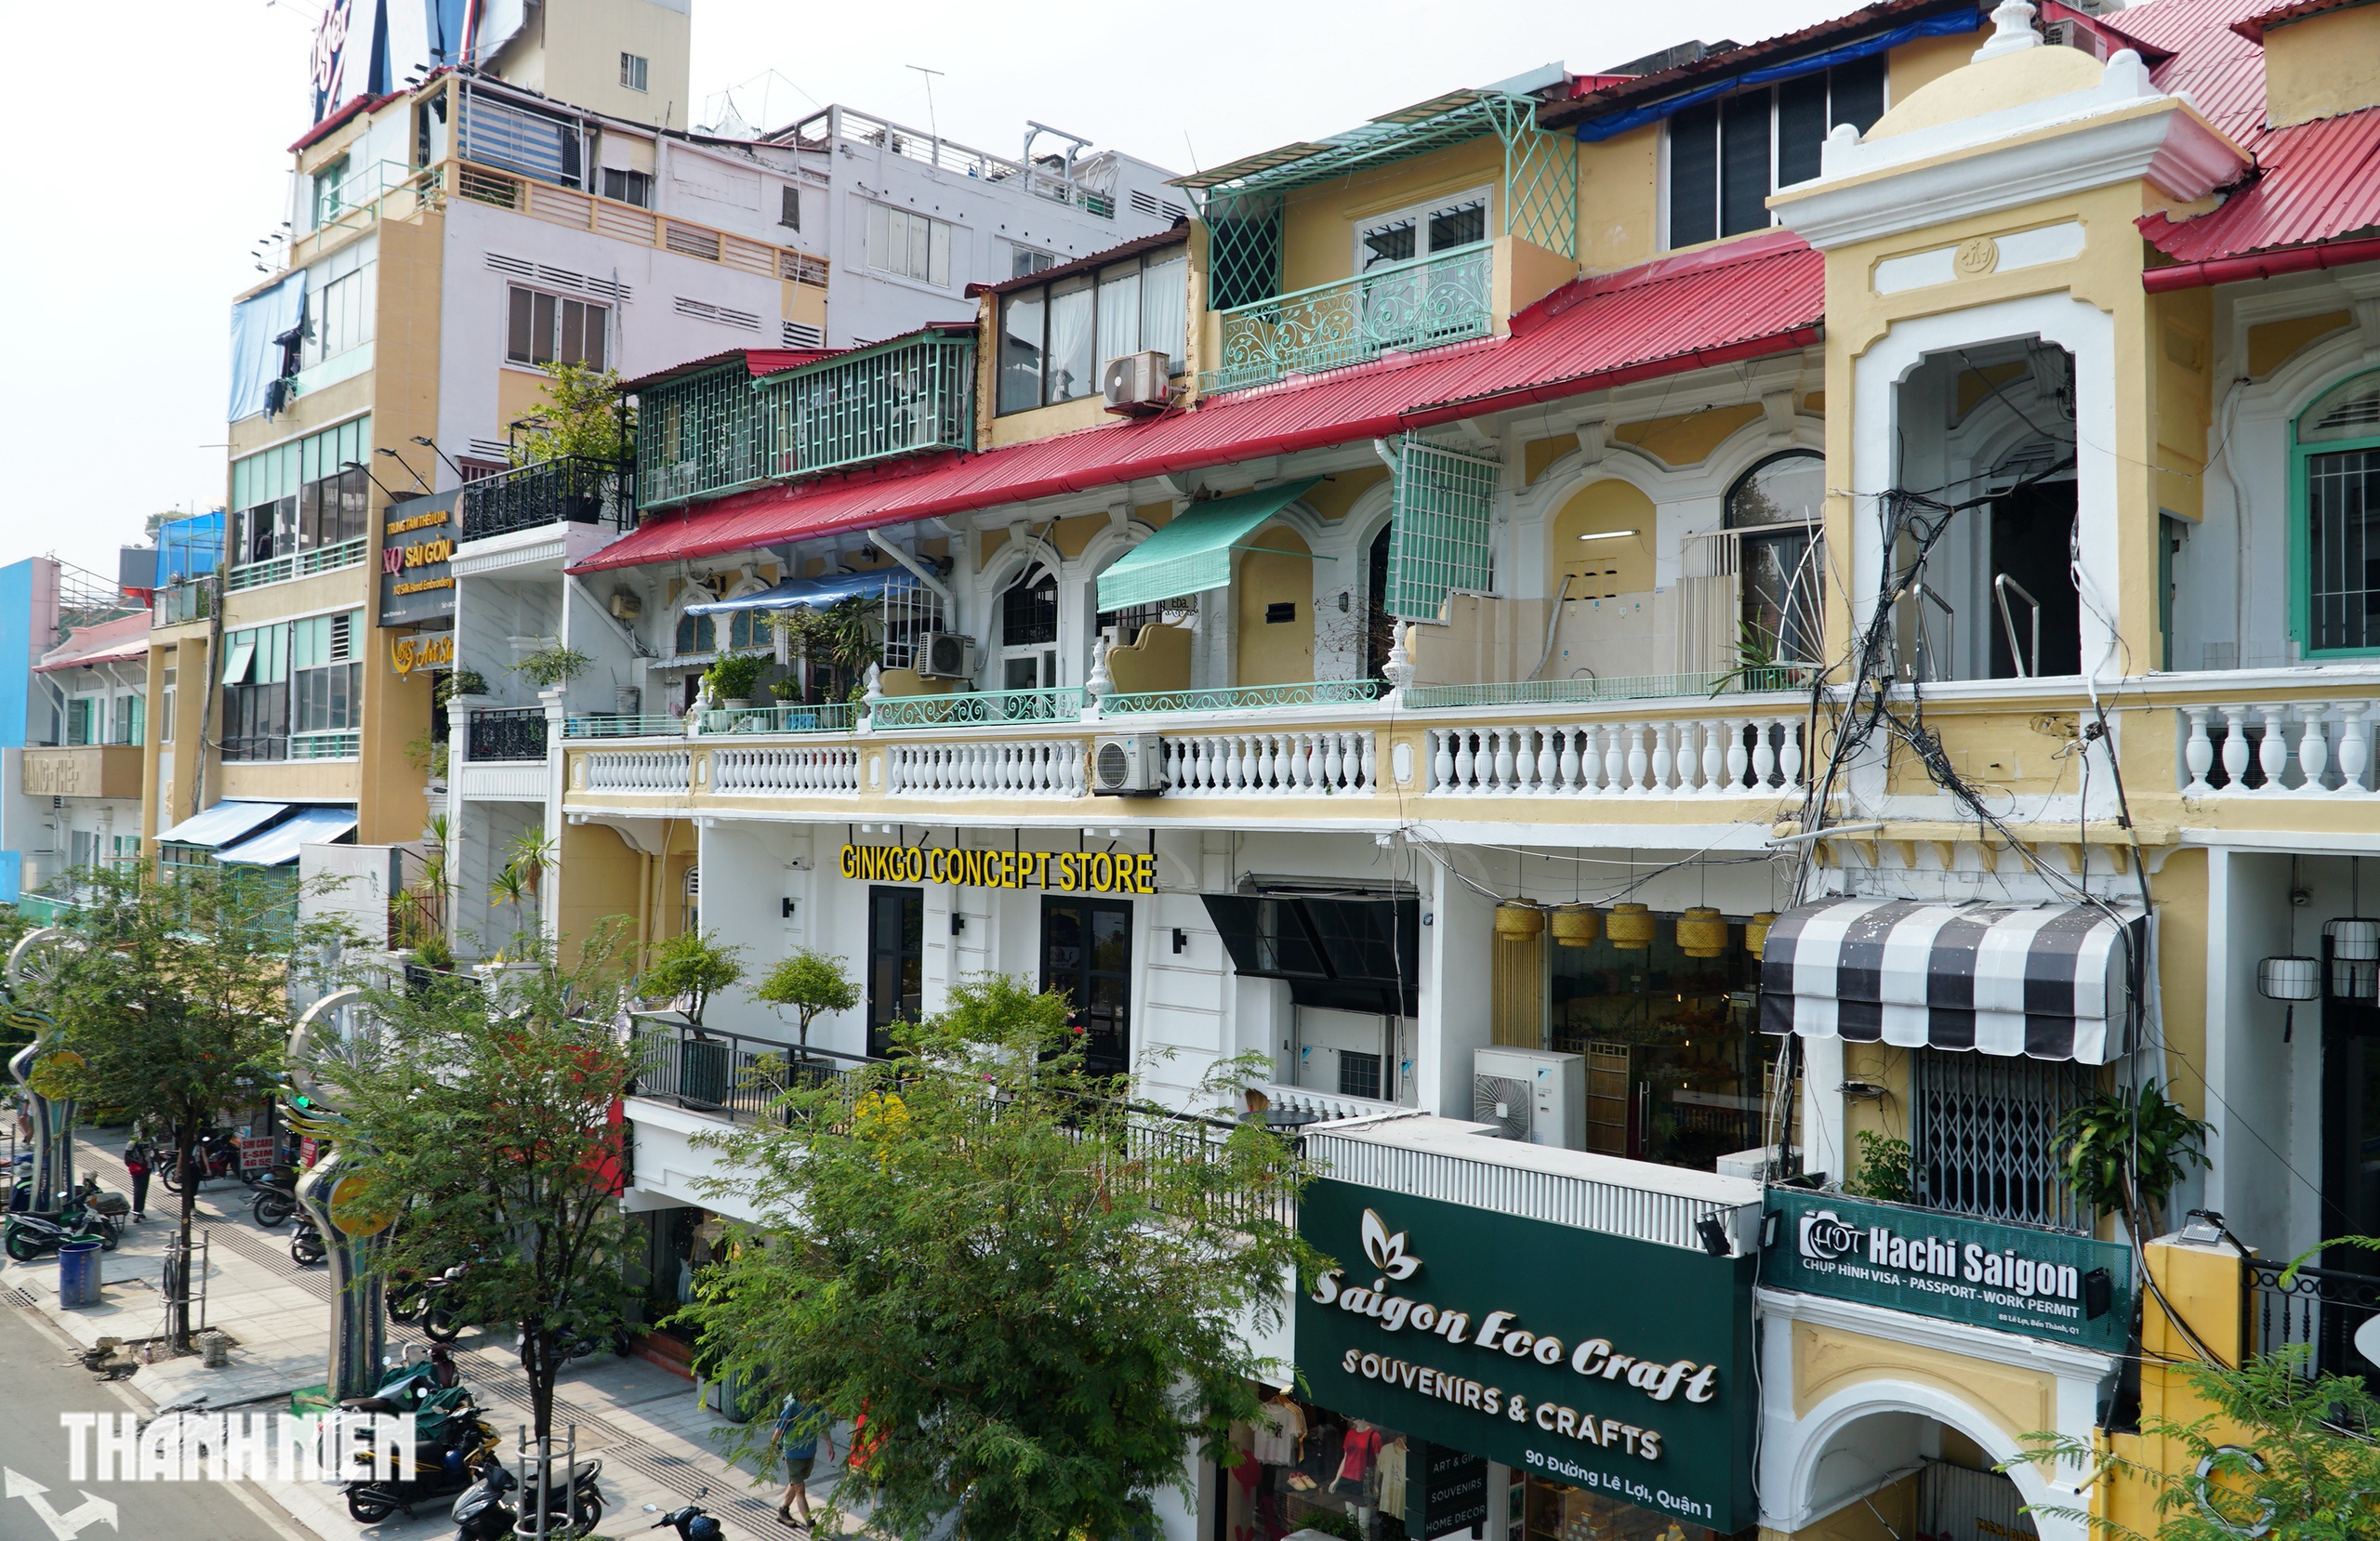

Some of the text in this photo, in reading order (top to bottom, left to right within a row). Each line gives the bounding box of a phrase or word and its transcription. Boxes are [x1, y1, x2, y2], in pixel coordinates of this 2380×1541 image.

[381, 533, 454, 577] XQ SÀI GÒN
[840, 844, 1158, 894] GINKGO CONCEPT STORE
[243, 1139, 273, 1150] SIM CARD
[243, 1149, 272, 1159] E-SIM
[244, 1159, 257, 1167] 4G
[1869, 1226, 2079, 1299] Hachi Saigon
[1803, 1258, 1836, 1275] CHỤP
[1837, 1262, 1870, 1281] HÌNH
[1871, 1269, 1901, 1286] VISA
[2027, 1297, 2080, 1318] PERMIT
[1312, 1268, 1717, 1403] Saigon Eco Craft
[2008, 1314, 2016, 1323] Lê
[2069, 1326, 2080, 1335] Q1
[1342, 1349, 1662, 1461] SOUVENIRS & CRAFTS
[1433, 1459, 1450, 1473] ART
[1452, 1456, 1460, 1468] &
[1432, 1478, 1483, 1503] SOUVENIRS
[1526, 1449, 1712, 1519] 90 Đường Lê Lợi, Quận 1
[1425, 1505, 1486, 1534] HOME DECOR
